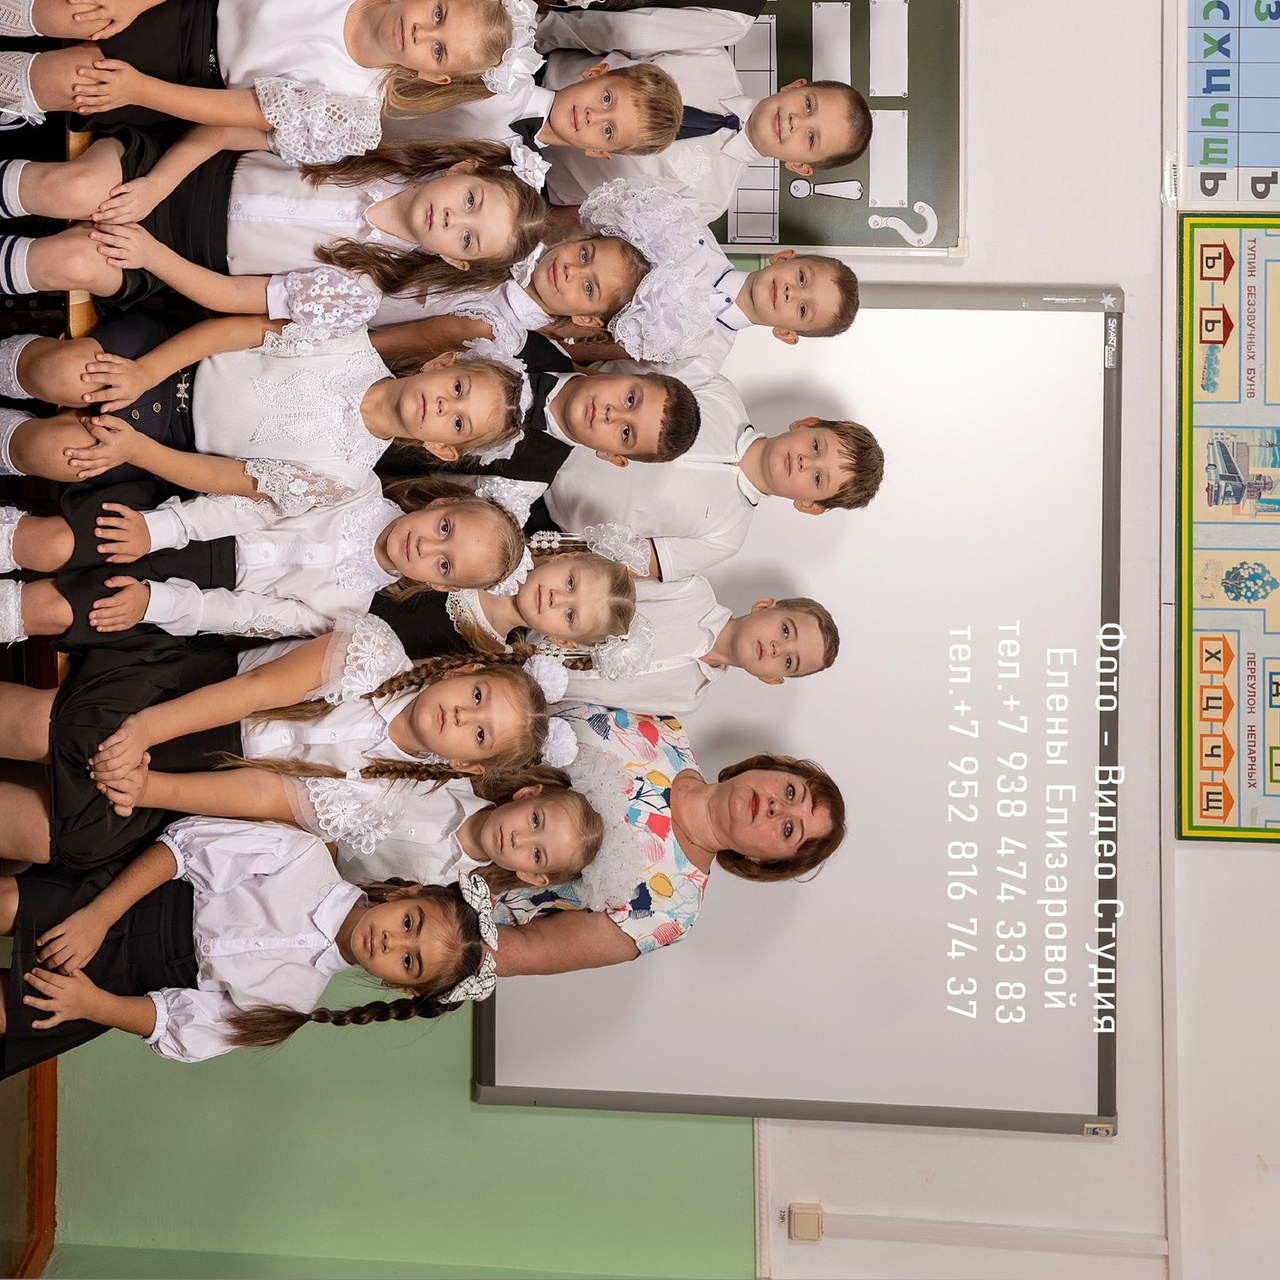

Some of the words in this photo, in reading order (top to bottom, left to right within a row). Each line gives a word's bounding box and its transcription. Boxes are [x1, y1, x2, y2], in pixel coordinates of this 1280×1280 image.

[1247, 238, 1257, 278] ТУПИК
[1108, 318, 1117, 347] SMART
[1246, 285, 1256, 361] БЕЗЗВУЧНЫХ
[1246, 368, 1256, 399] БУКВ
[1247, 652, 1257, 714] ПЕРЕУЛОК
[1202, 696, 1222, 711] Ц
[1205, 745, 1221, 759] Ч
[1246, 724, 1257, 789] НЕПАРНЫХ
[1203, 791, 1222, 812] Щ
